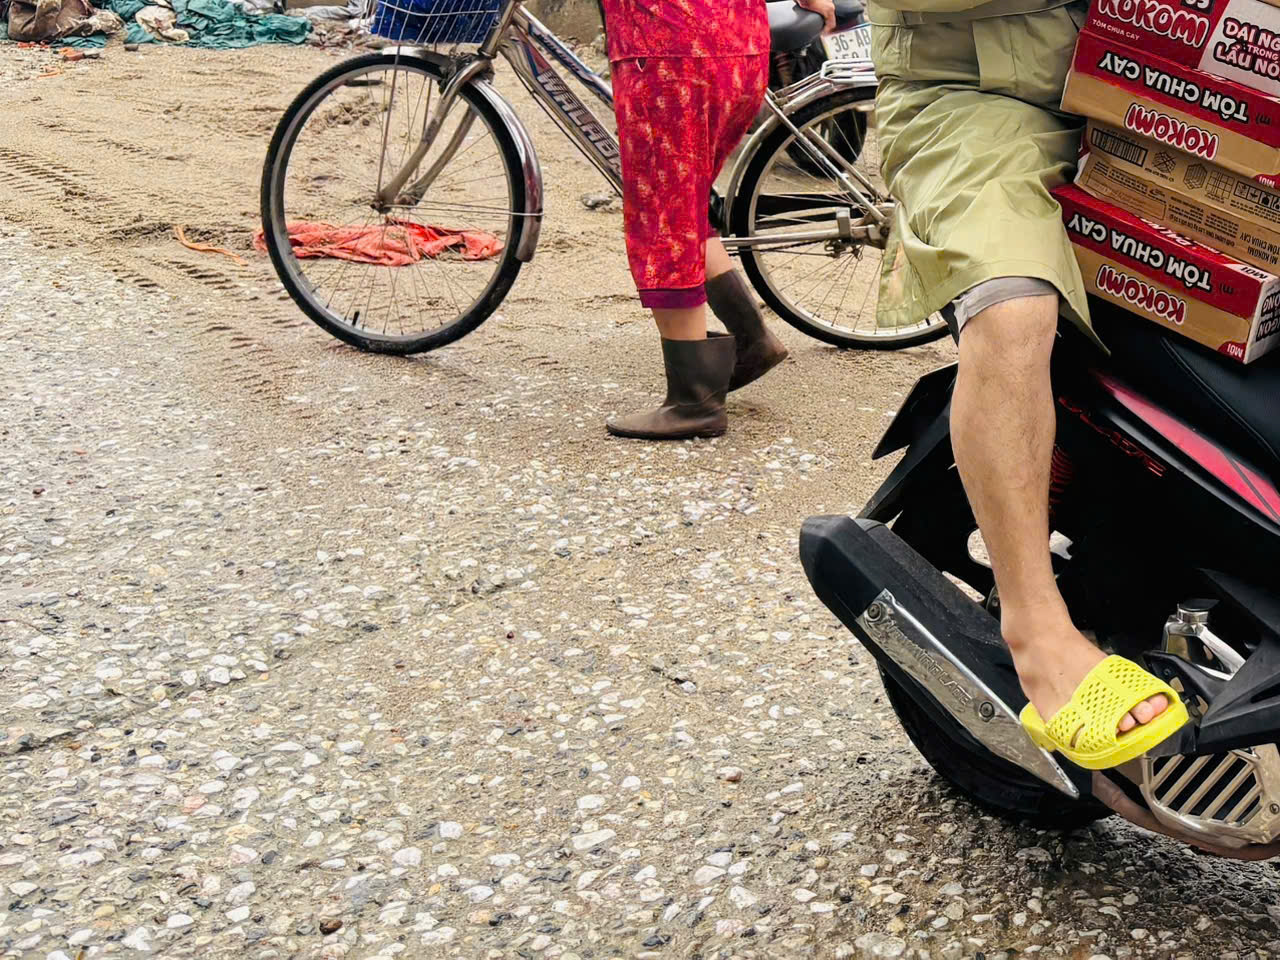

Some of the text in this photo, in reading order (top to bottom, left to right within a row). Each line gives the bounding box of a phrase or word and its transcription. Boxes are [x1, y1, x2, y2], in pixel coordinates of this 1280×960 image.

[1107, 25, 1125, 36] CHUA
[1125, 31, 1140, 41] CAY
[1100, 52, 1140, 79] CAY
[1247, 44, 1279, 61] TRONG
[1144, 67, 1200, 102] CHUA
[1202, 90, 1248, 122] TÔM
[1124, 103, 1219, 160] KOKOMI
[1068, 214, 1107, 241] CAY
[1240, 232, 1251, 243] CAY
[1111, 230, 1164, 268] CHUA
[1251, 236, 1267, 252] CHUA
[1166, 256, 1211, 290] TÔM
[1097, 264, 1186, 325] KOKOMI
